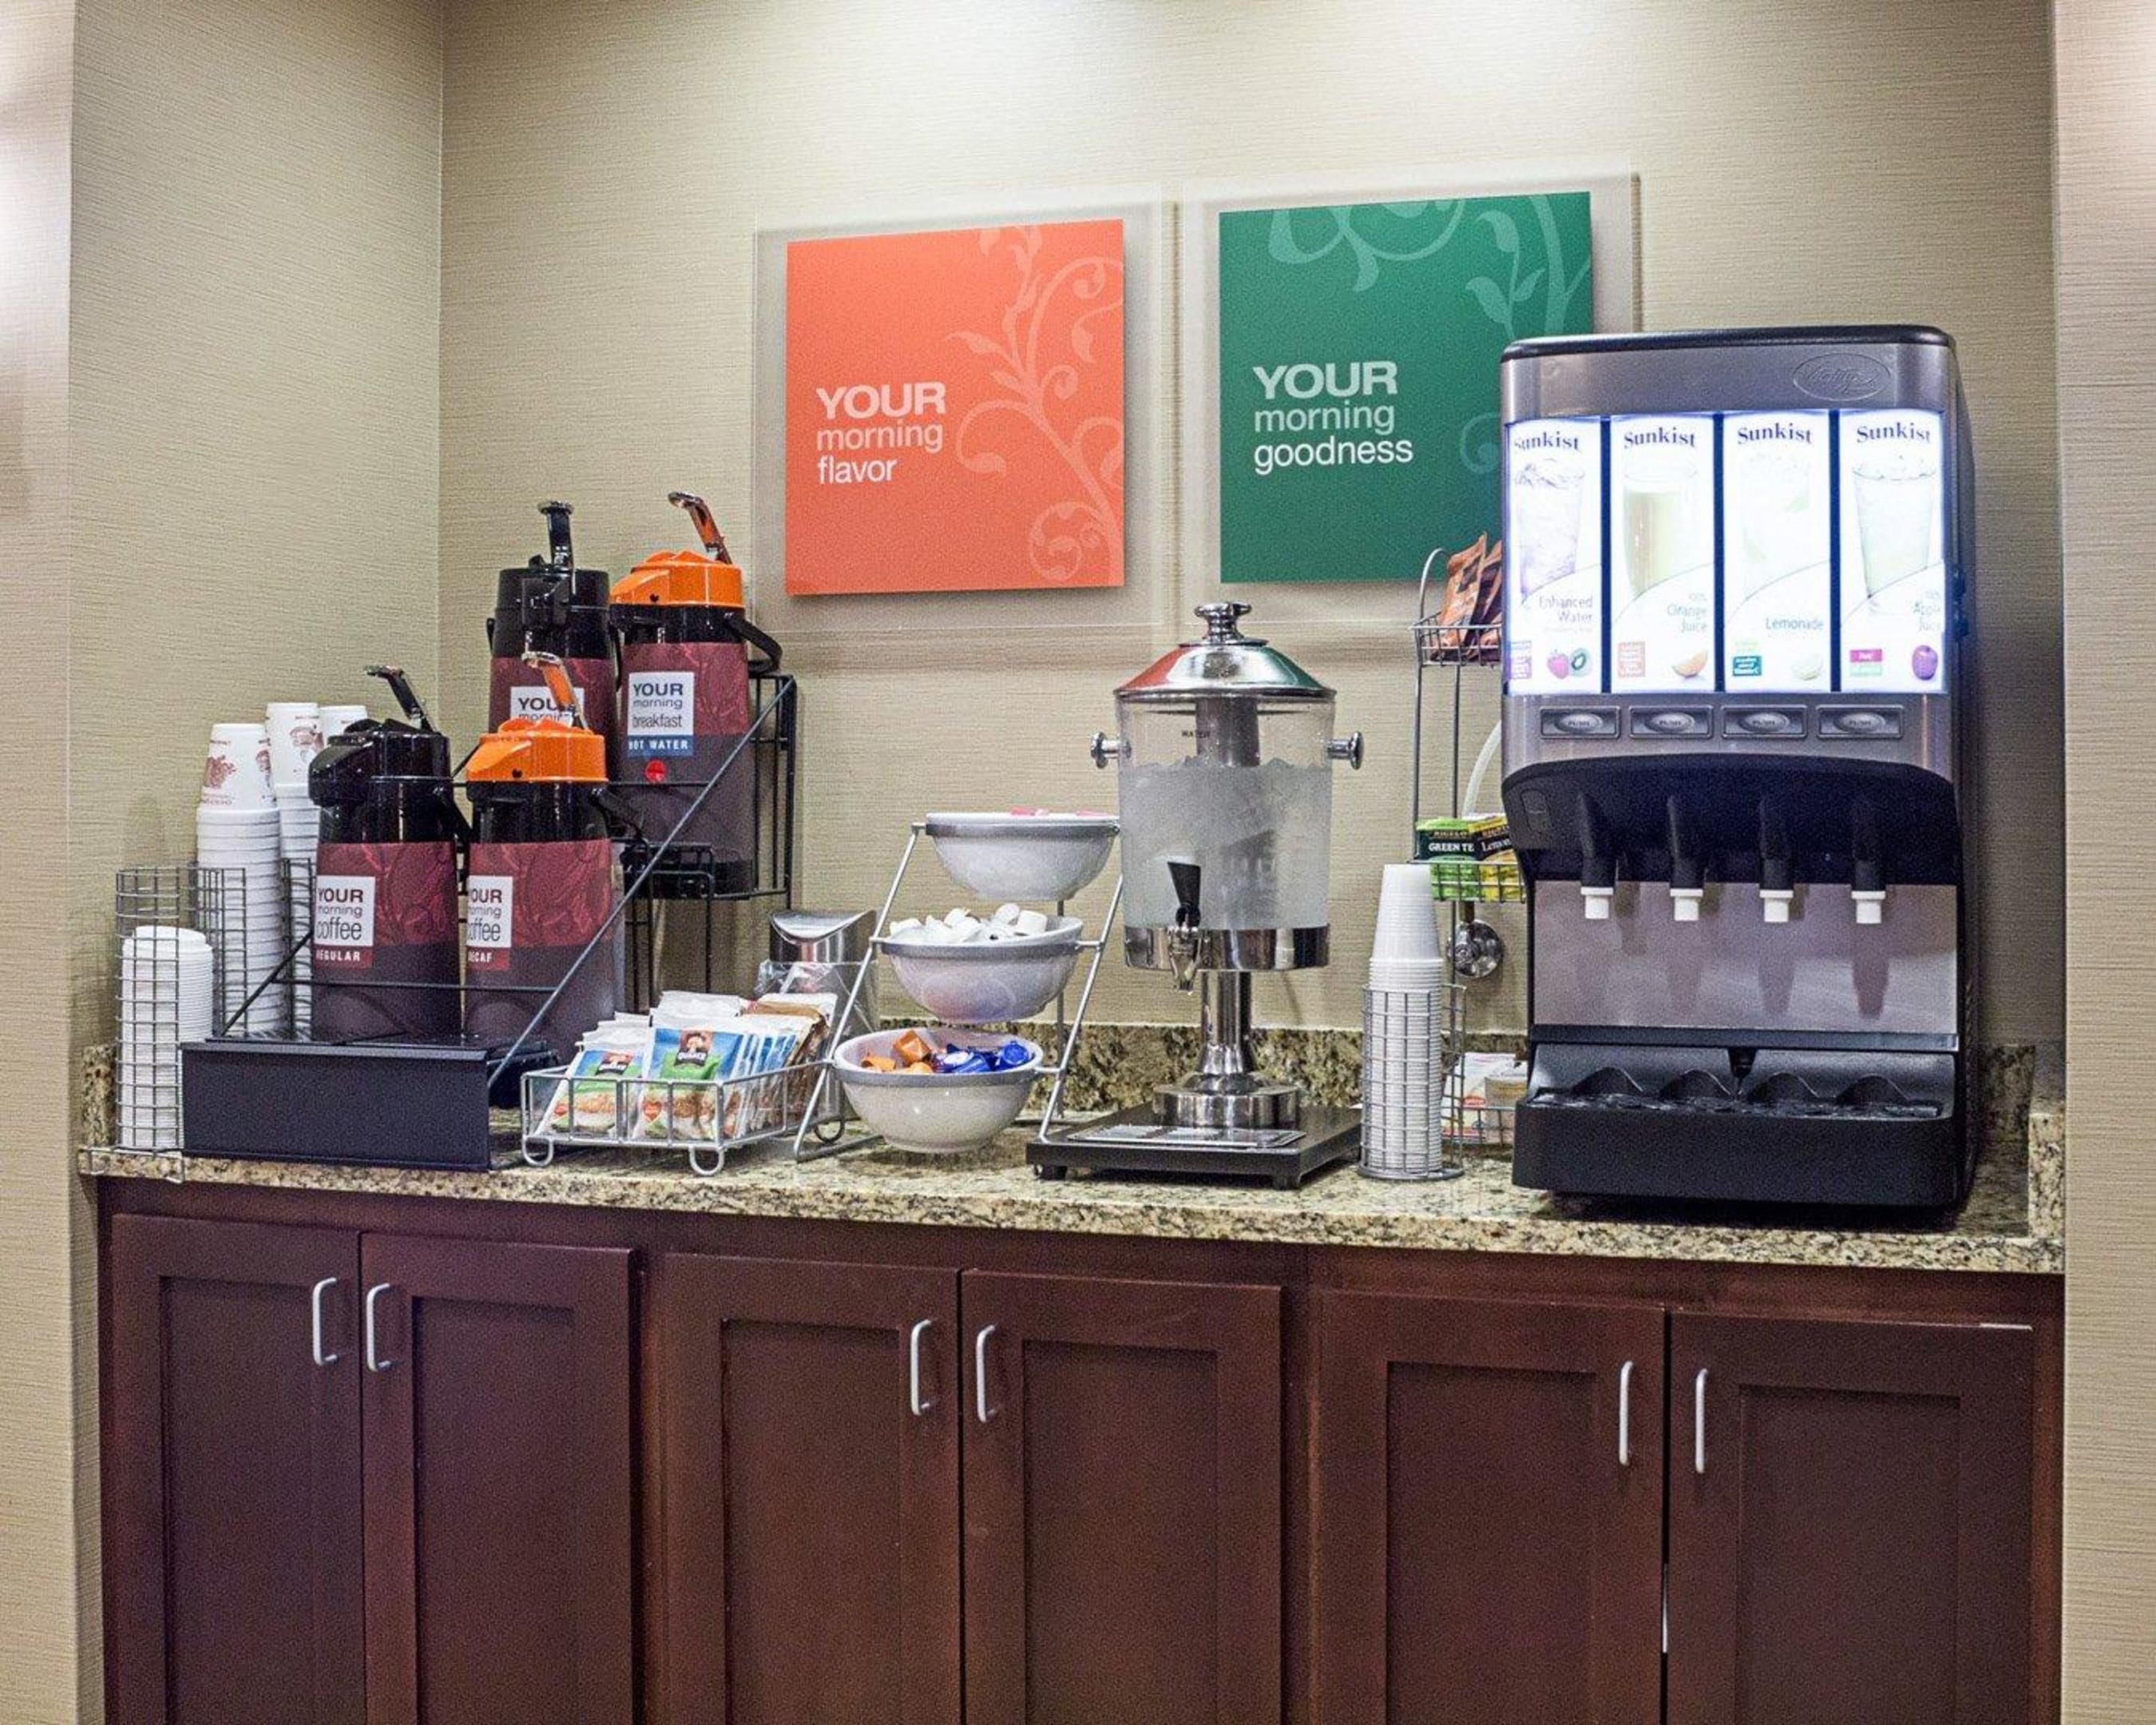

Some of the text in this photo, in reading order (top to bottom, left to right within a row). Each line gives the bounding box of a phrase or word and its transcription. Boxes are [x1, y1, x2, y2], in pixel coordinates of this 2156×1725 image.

[1252, 360, 1398, 400] YOUR
[816, 381, 946, 419] YOUR
[1255, 399, 1395, 435] morning
[817, 419, 943, 454] morning
[1624, 427, 1696, 448] Sunkist
[1737, 422, 1812, 445] Sunkist
[1856, 422, 1931, 443] Sunkist
[1254, 435, 1414, 475] goodness
[817, 455, 897, 484] flavor
[1538, 595, 1593, 609] Enhanced
[1558, 609, 1592, 623] Water
[1765, 617, 1824, 630] Lemonade
[633, 683, 683, 696] YOUR
[633, 699, 683, 710] morning
[633, 714, 683, 728] breakfast
[648, 739, 689, 750] WATER
[1428, 842, 1460, 852] GREEN
[317, 888, 364, 903] YOUR
[316, 916, 362, 940] coffee
